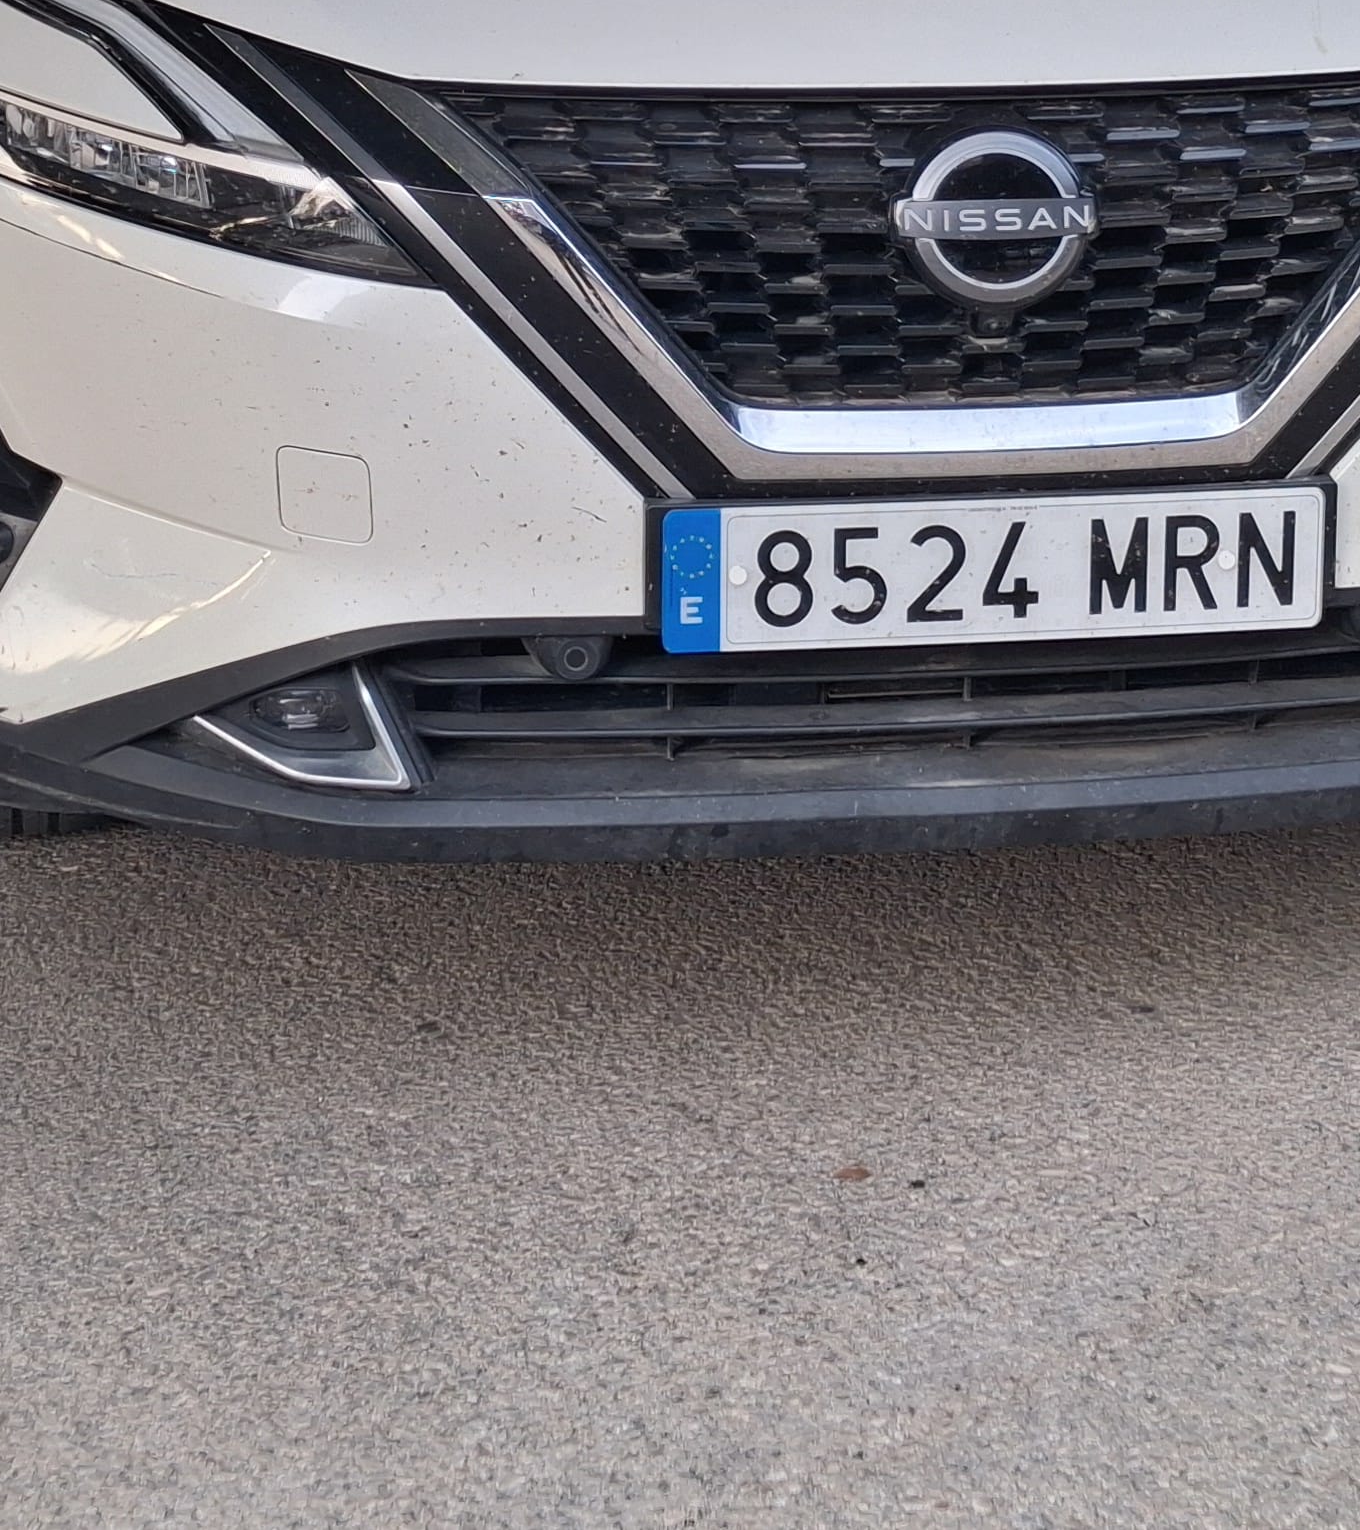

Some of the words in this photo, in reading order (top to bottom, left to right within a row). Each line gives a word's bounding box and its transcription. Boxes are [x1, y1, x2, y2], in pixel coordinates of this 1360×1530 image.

[903, 204, 1090, 232] NISSAN
[753, 519, 1040, 629] 8524
[1088, 510, 1297, 616] MRN
[679, 596, 704, 625] E
